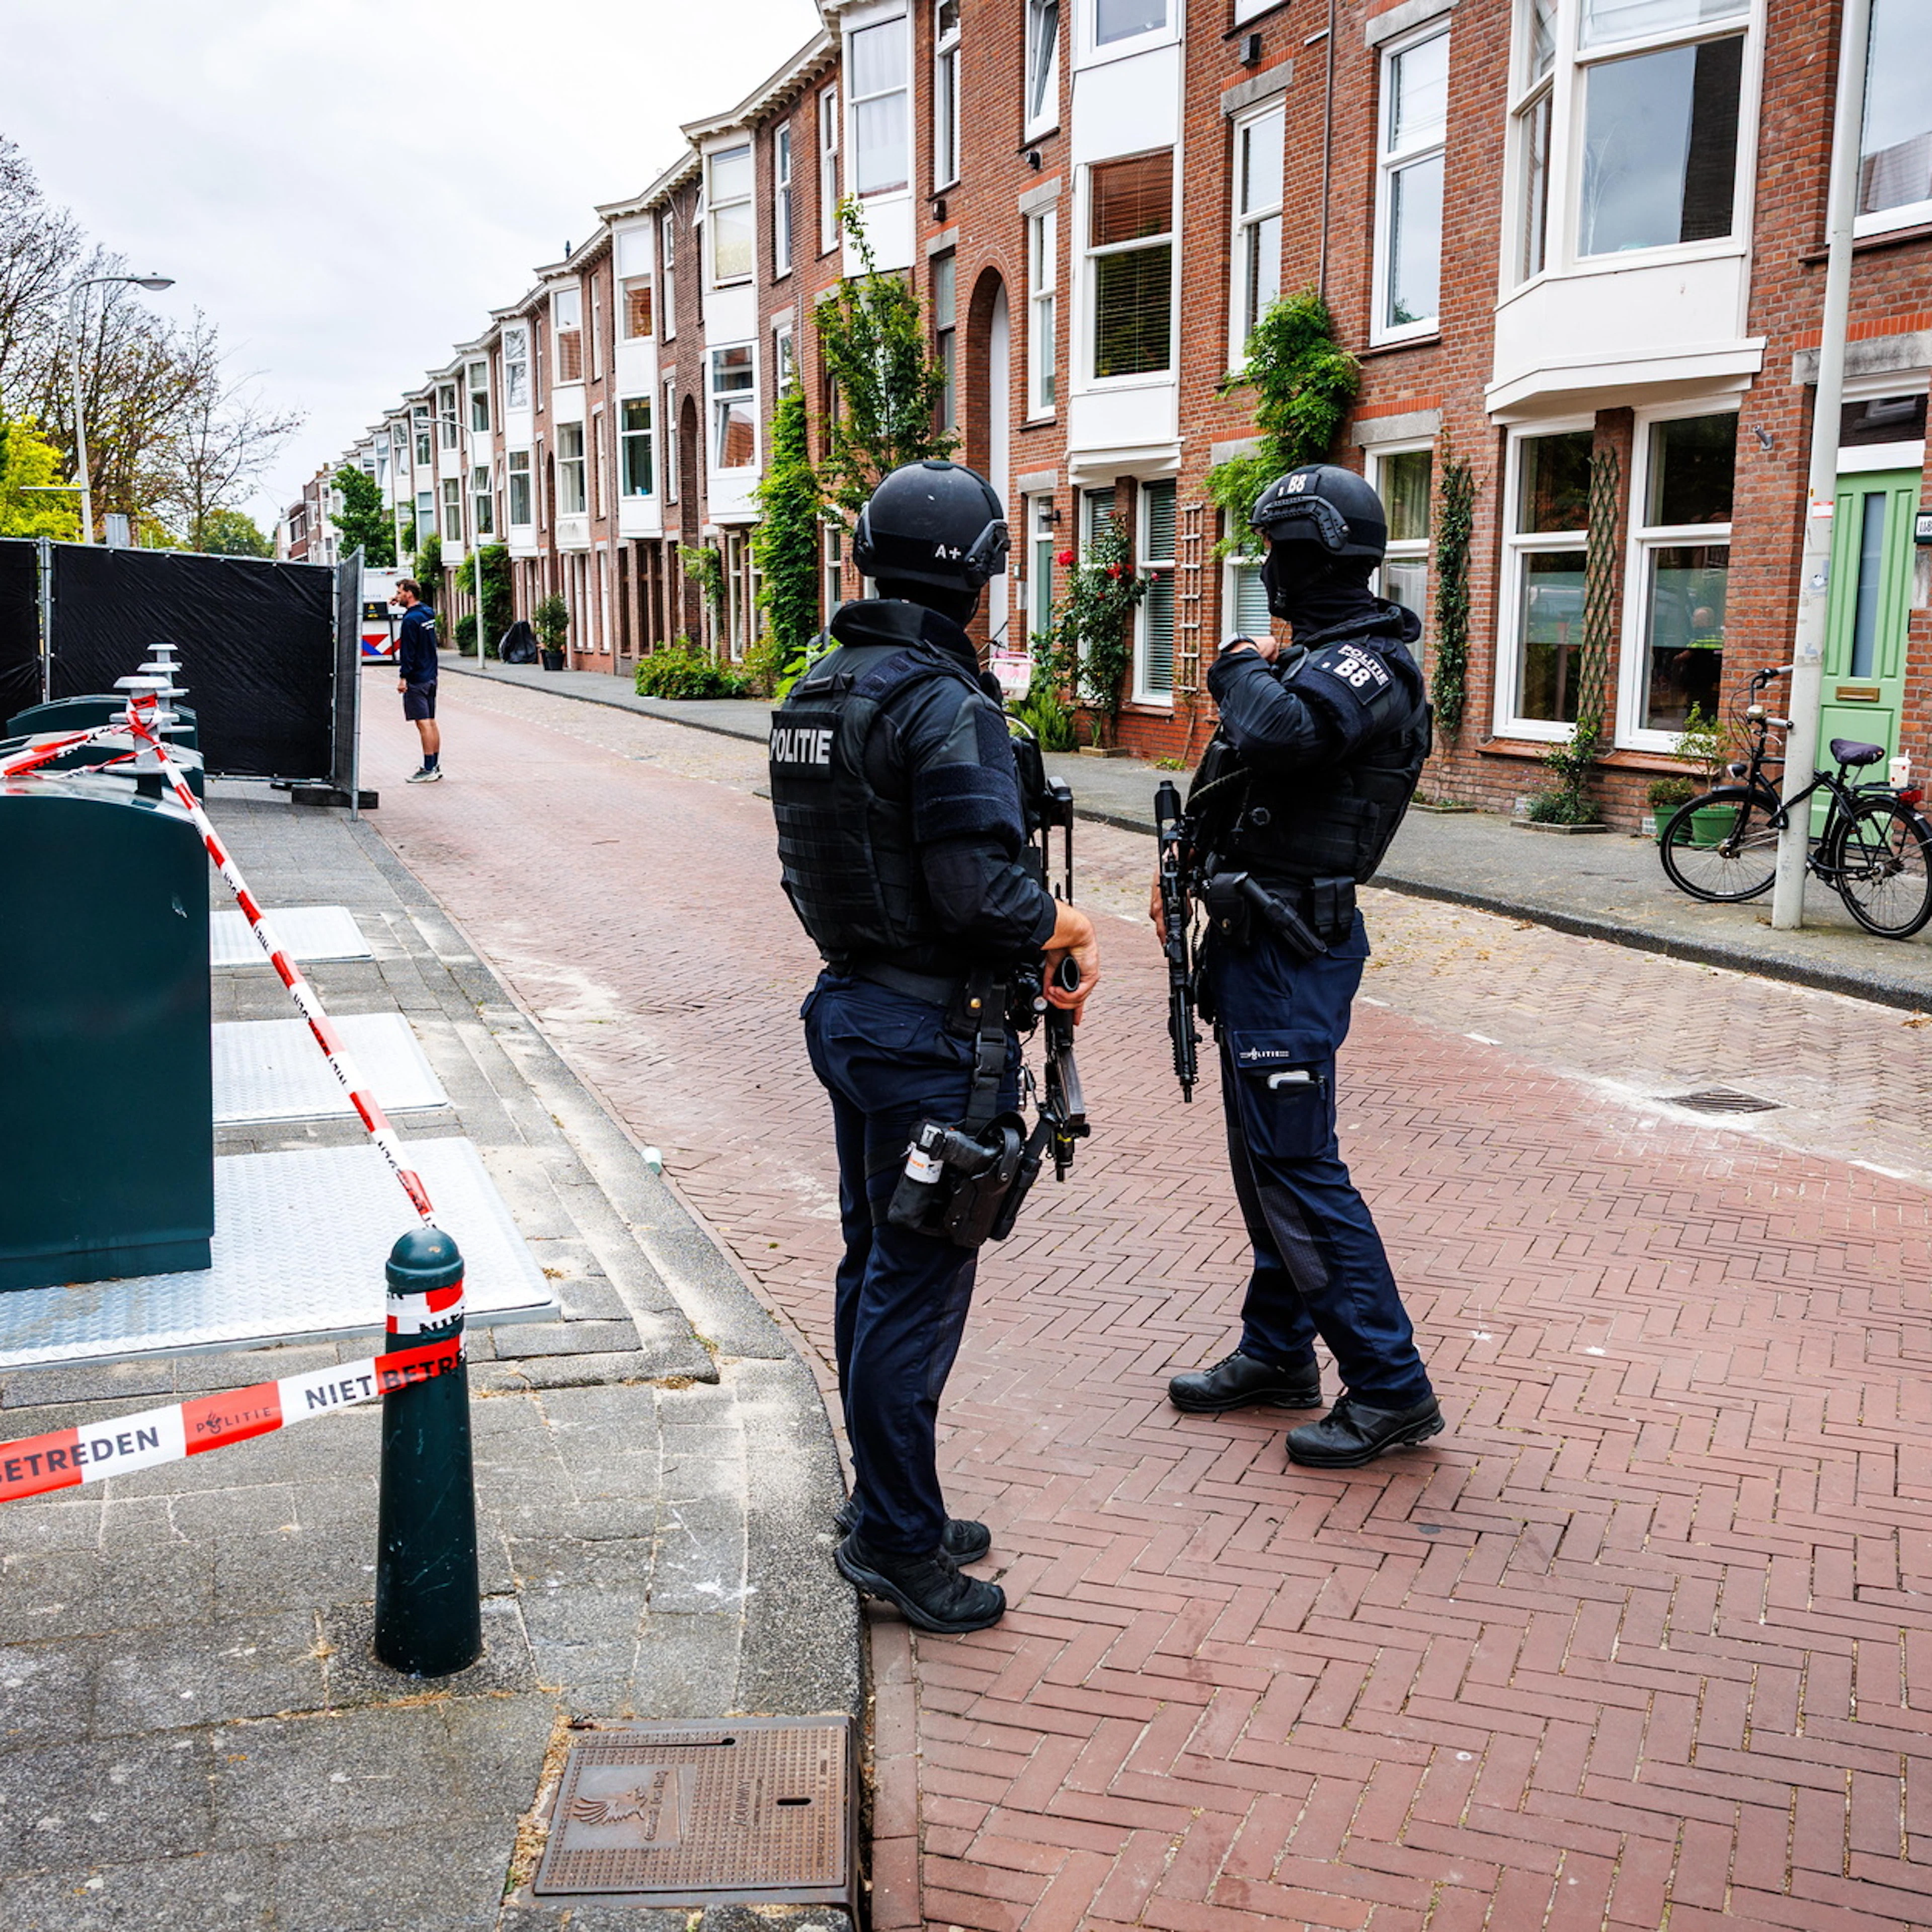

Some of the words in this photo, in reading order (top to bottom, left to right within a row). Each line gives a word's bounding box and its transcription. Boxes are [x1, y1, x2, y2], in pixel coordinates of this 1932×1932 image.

[1287, 474, 1307, 494] B8
[935, 544, 961, 559] A+
[1333, 658, 1371, 687] B8
[1337, 644, 1389, 686] POLITIE
[0, 1426, 159, 1482] ETREDEN
[305, 1375, 372, 1409] NIET
